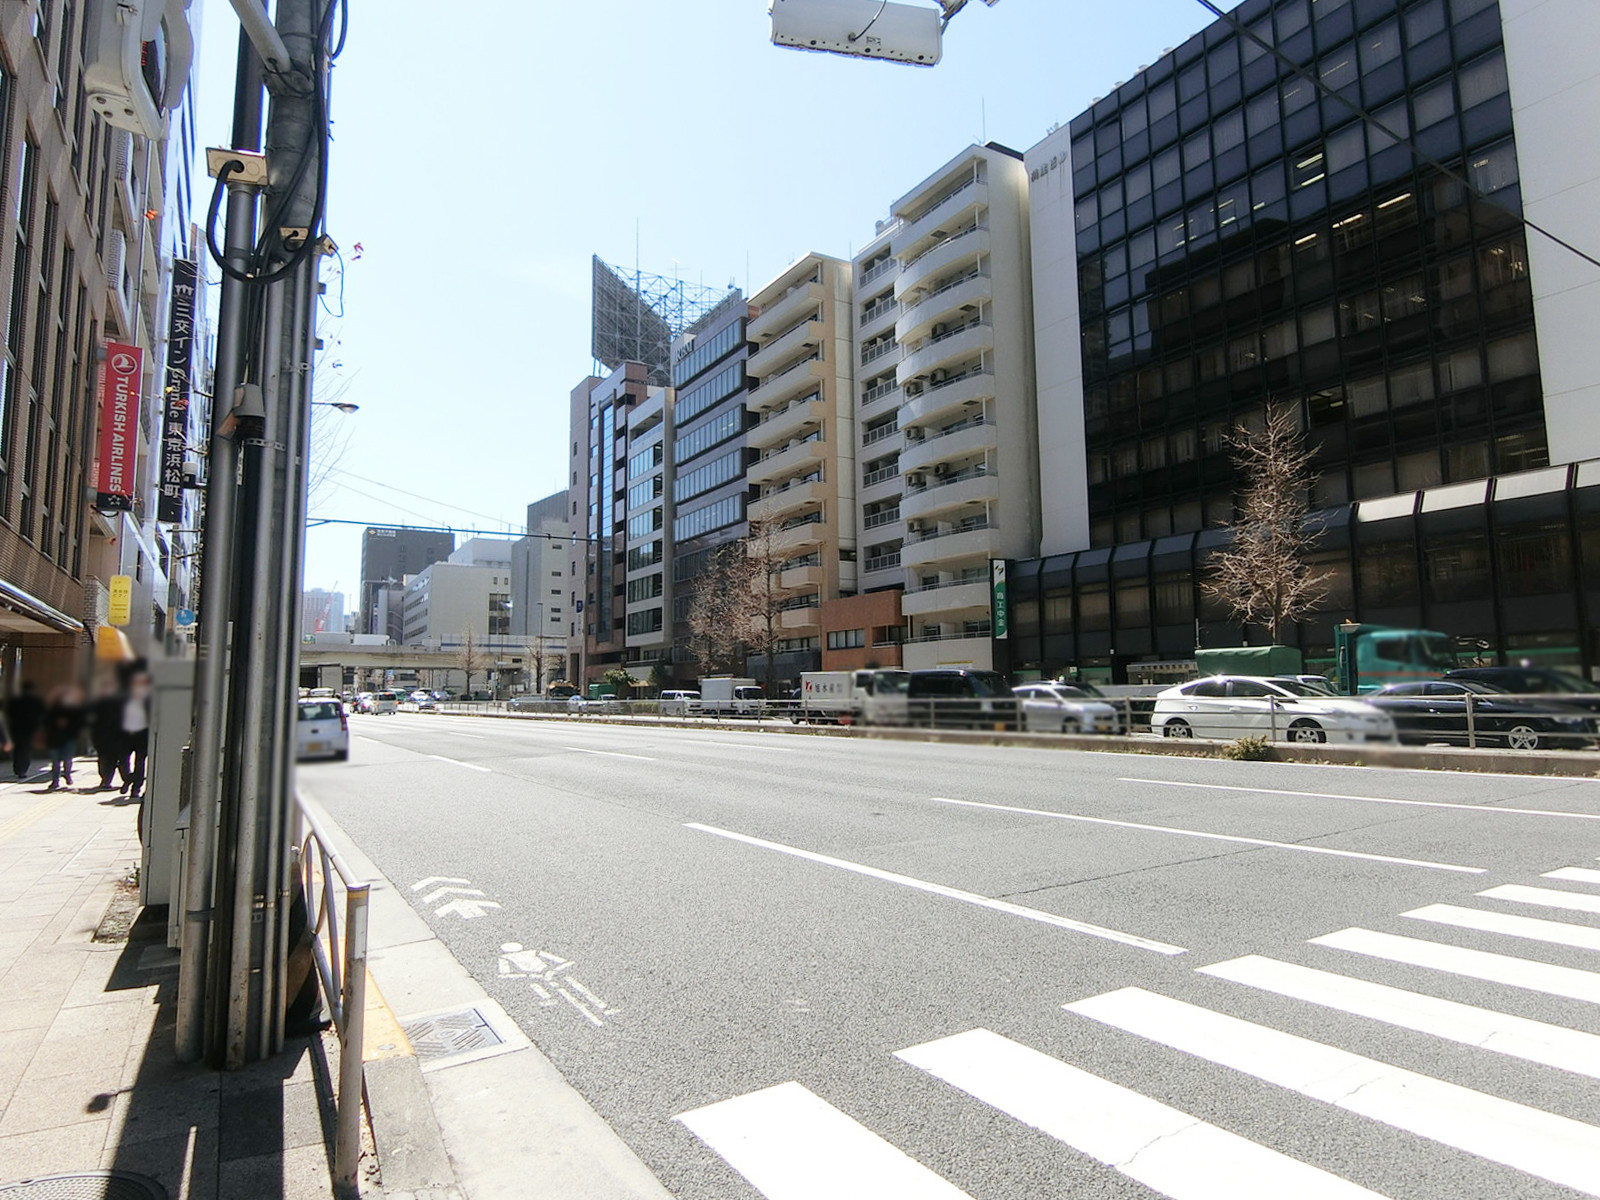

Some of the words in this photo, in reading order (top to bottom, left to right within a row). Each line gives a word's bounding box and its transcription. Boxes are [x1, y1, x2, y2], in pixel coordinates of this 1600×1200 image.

[113, 376, 129, 432] TURKISH
[109, 432, 125, 492] AIRLINES
[164, 422, 183, 498] 東京浜松町
